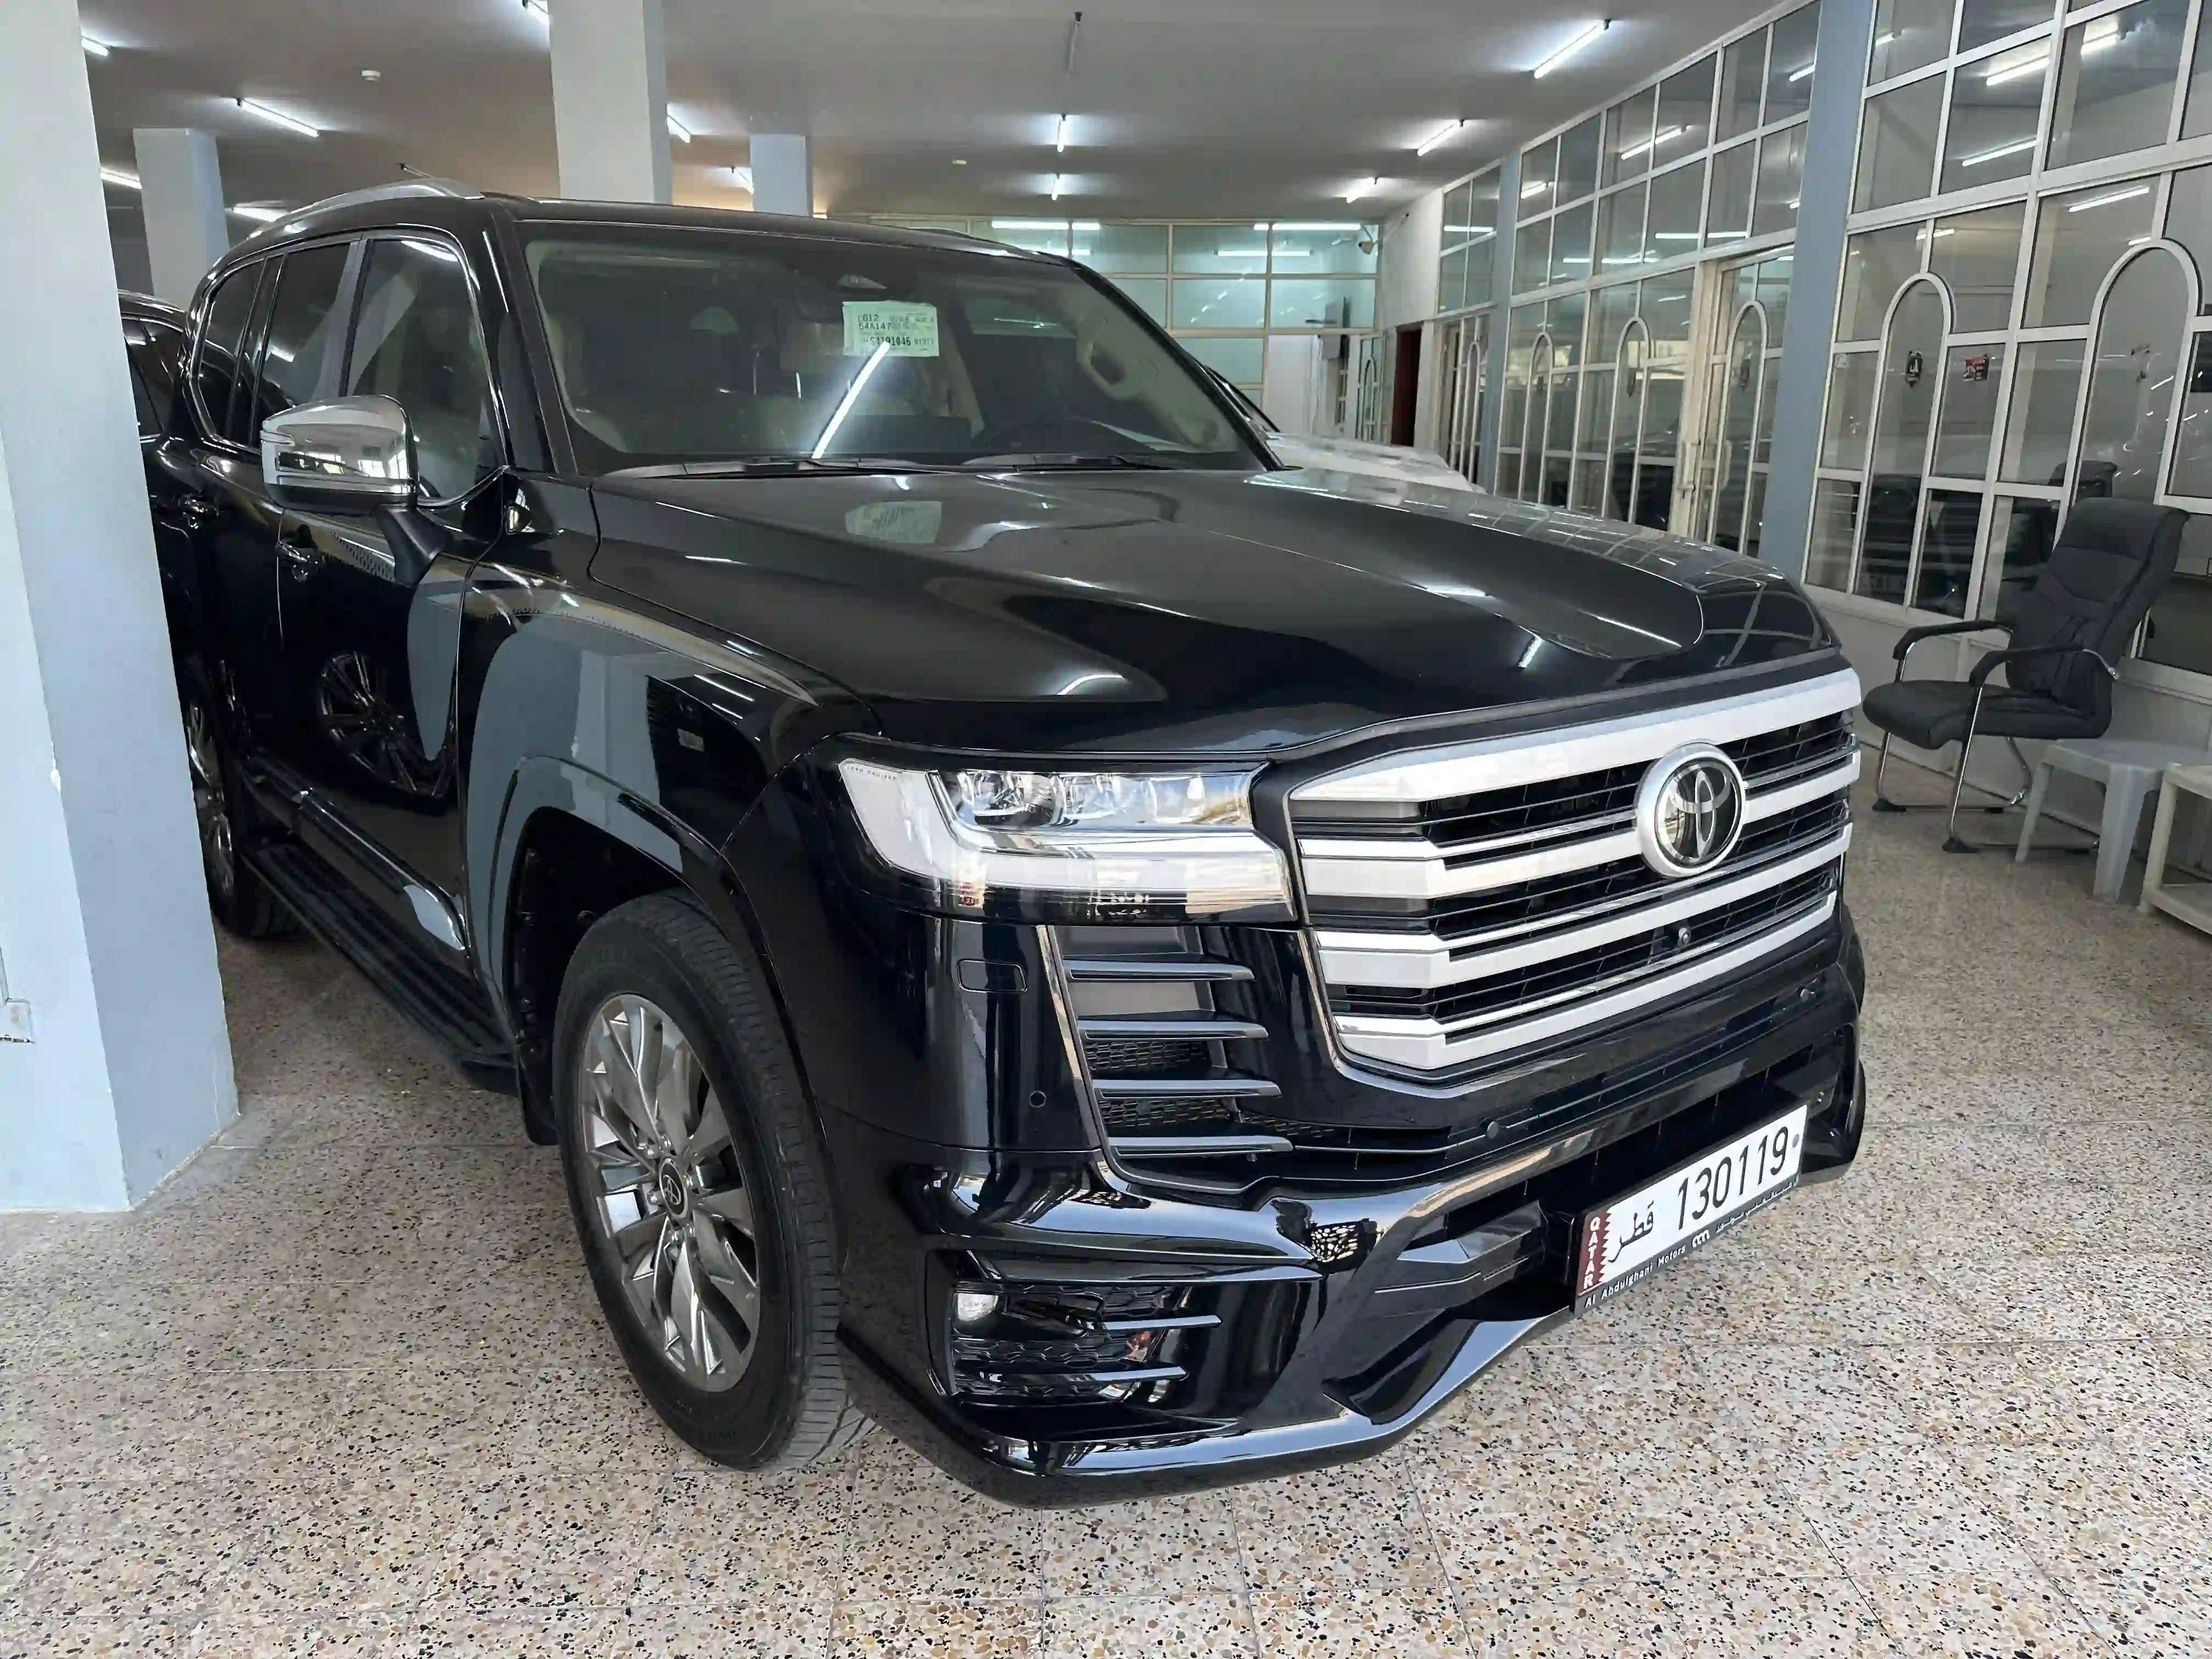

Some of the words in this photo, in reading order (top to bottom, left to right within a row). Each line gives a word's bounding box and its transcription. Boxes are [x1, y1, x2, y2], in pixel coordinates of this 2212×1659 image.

[1677, 1125, 1790, 1231] 130119
[1583, 1216, 1601, 1289] QATAR
[1608, 1200, 1655, 1264] قطر
[1585, 1293, 1596, 1309] Al
[1601, 1262, 1653, 1300] Abdulghani
[1657, 1244, 1686, 1269] Motors
